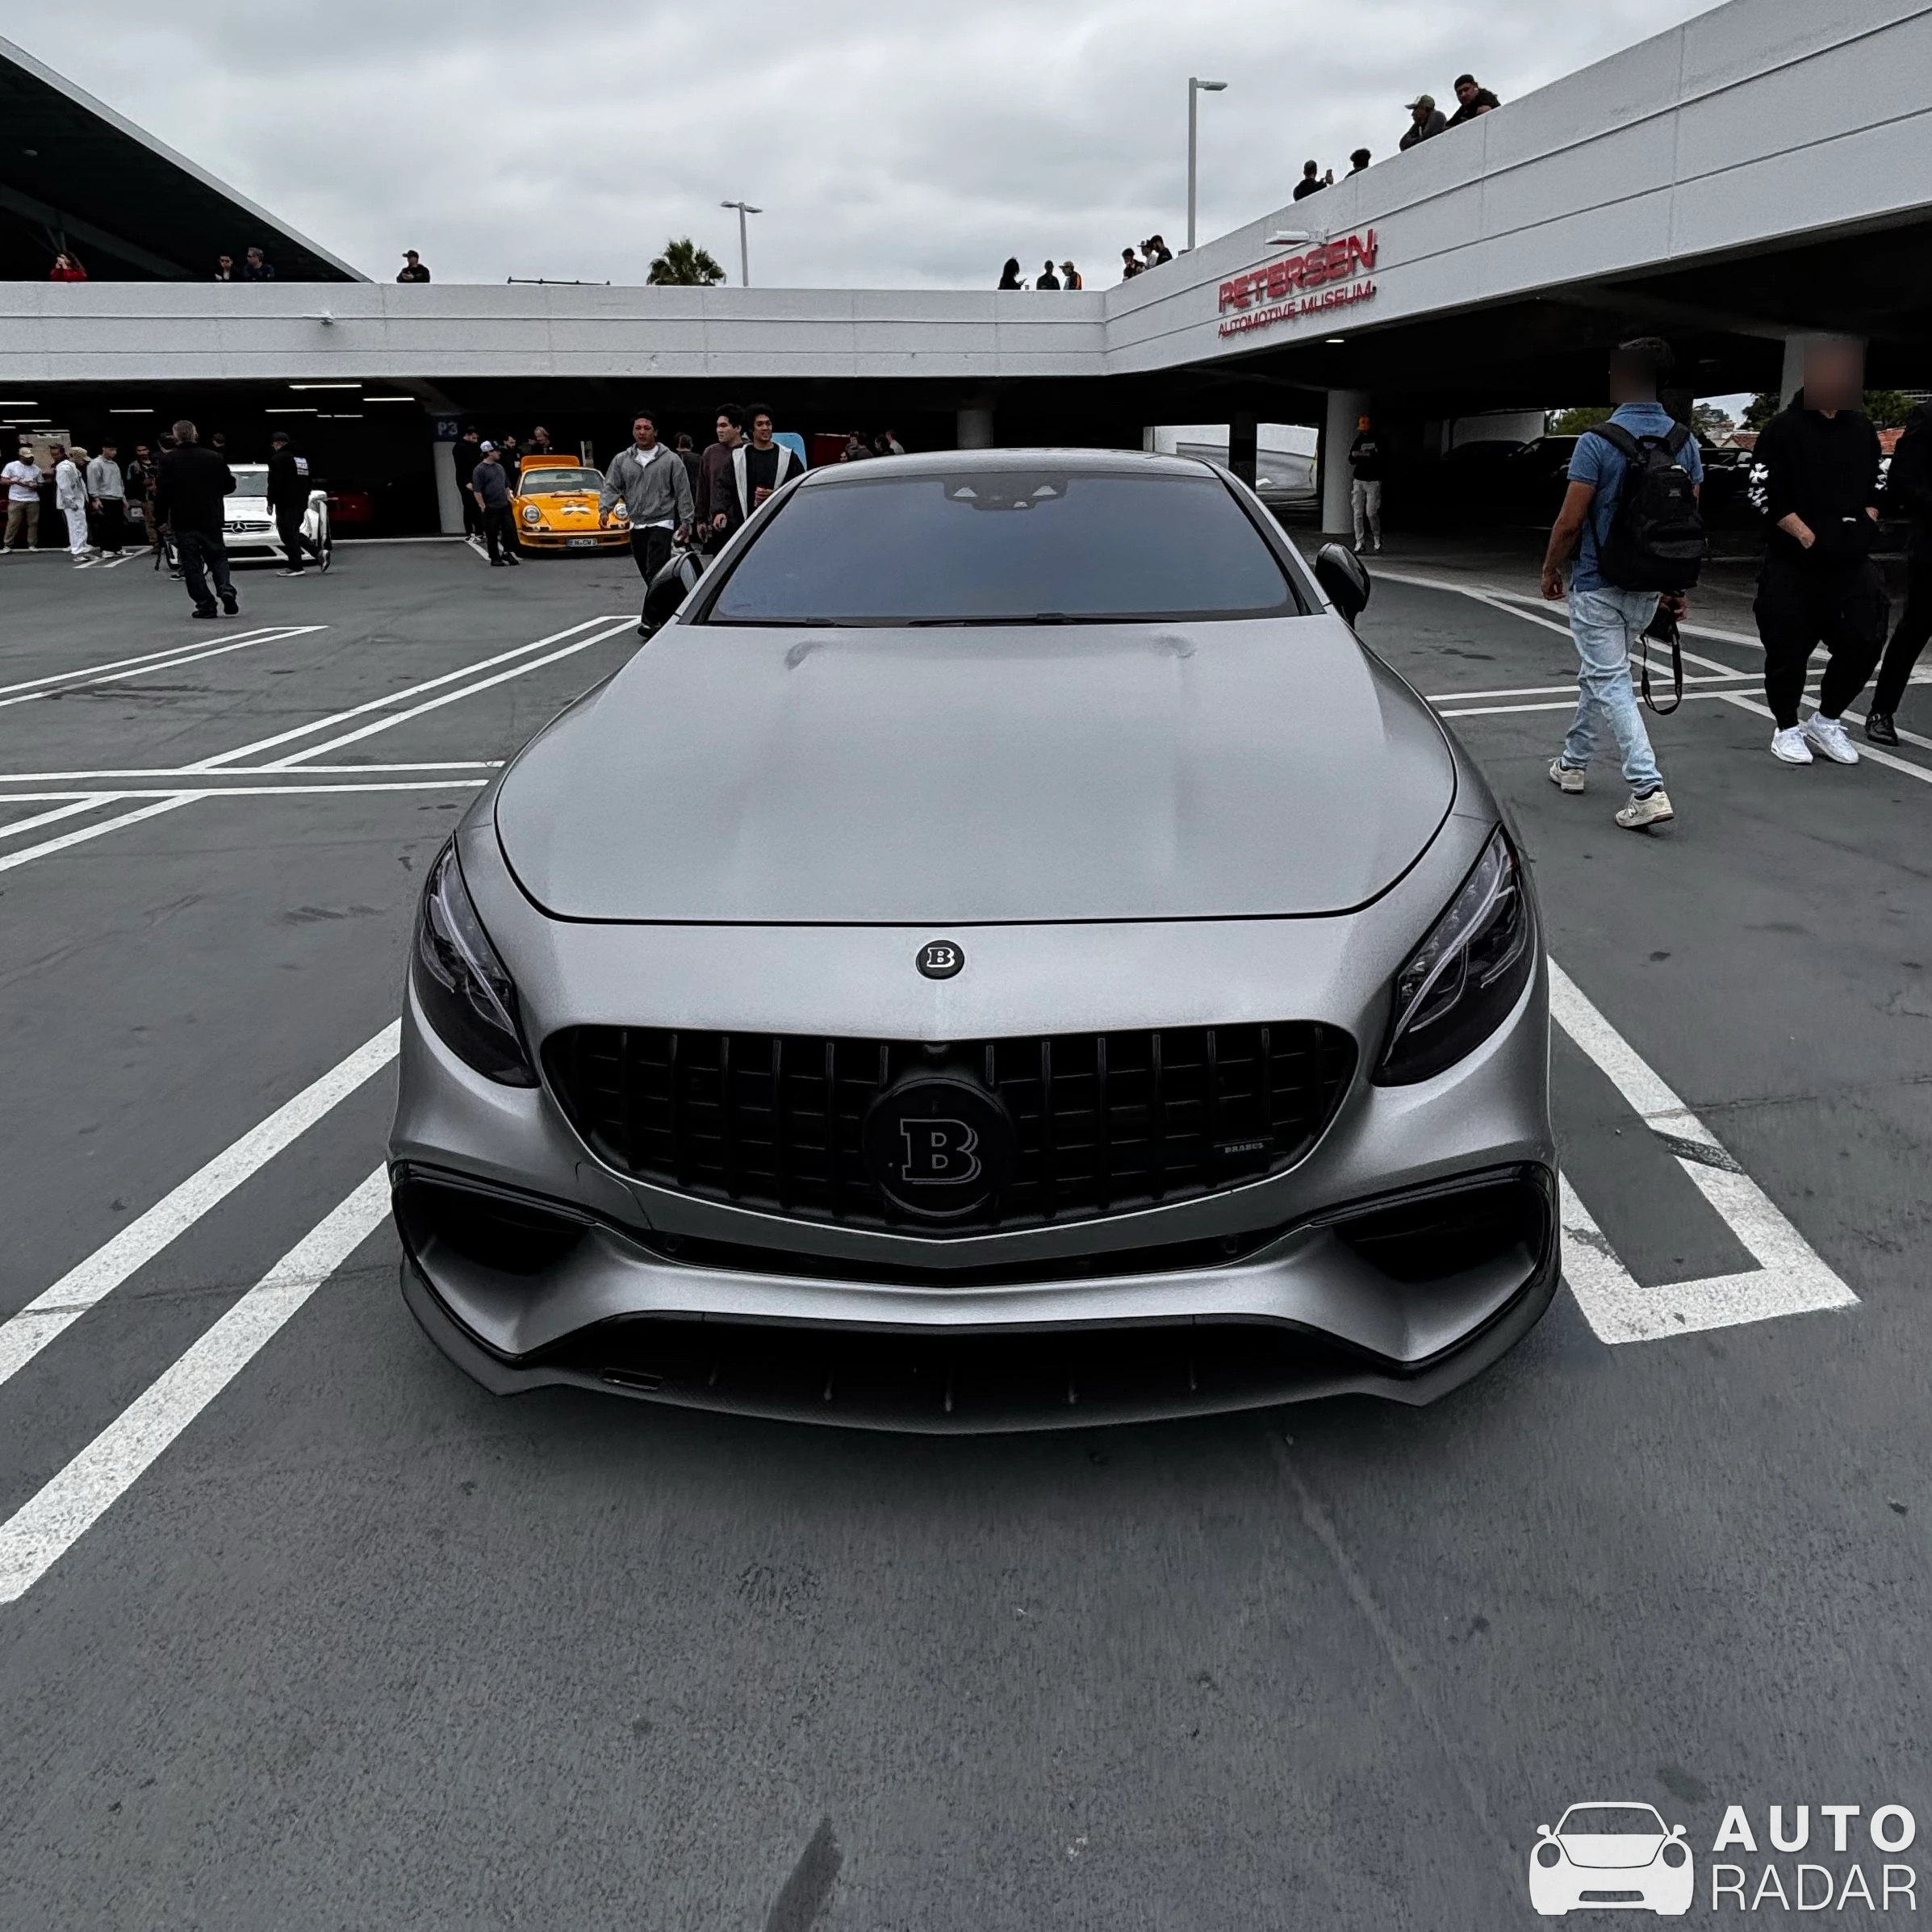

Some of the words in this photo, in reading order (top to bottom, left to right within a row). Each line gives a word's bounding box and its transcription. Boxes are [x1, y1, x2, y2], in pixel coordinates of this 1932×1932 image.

[1218, 228, 1376, 313] PETERSEN
[1218, 302, 1296, 338] AUTOMOTIVE
[1300, 280, 1375, 316] MUSEUM
[437, 421, 458, 436] P3
[926, 947, 956, 968] B
[900, 1119, 982, 1185] B
[1224, 1142, 1264, 1153] BRABUS
